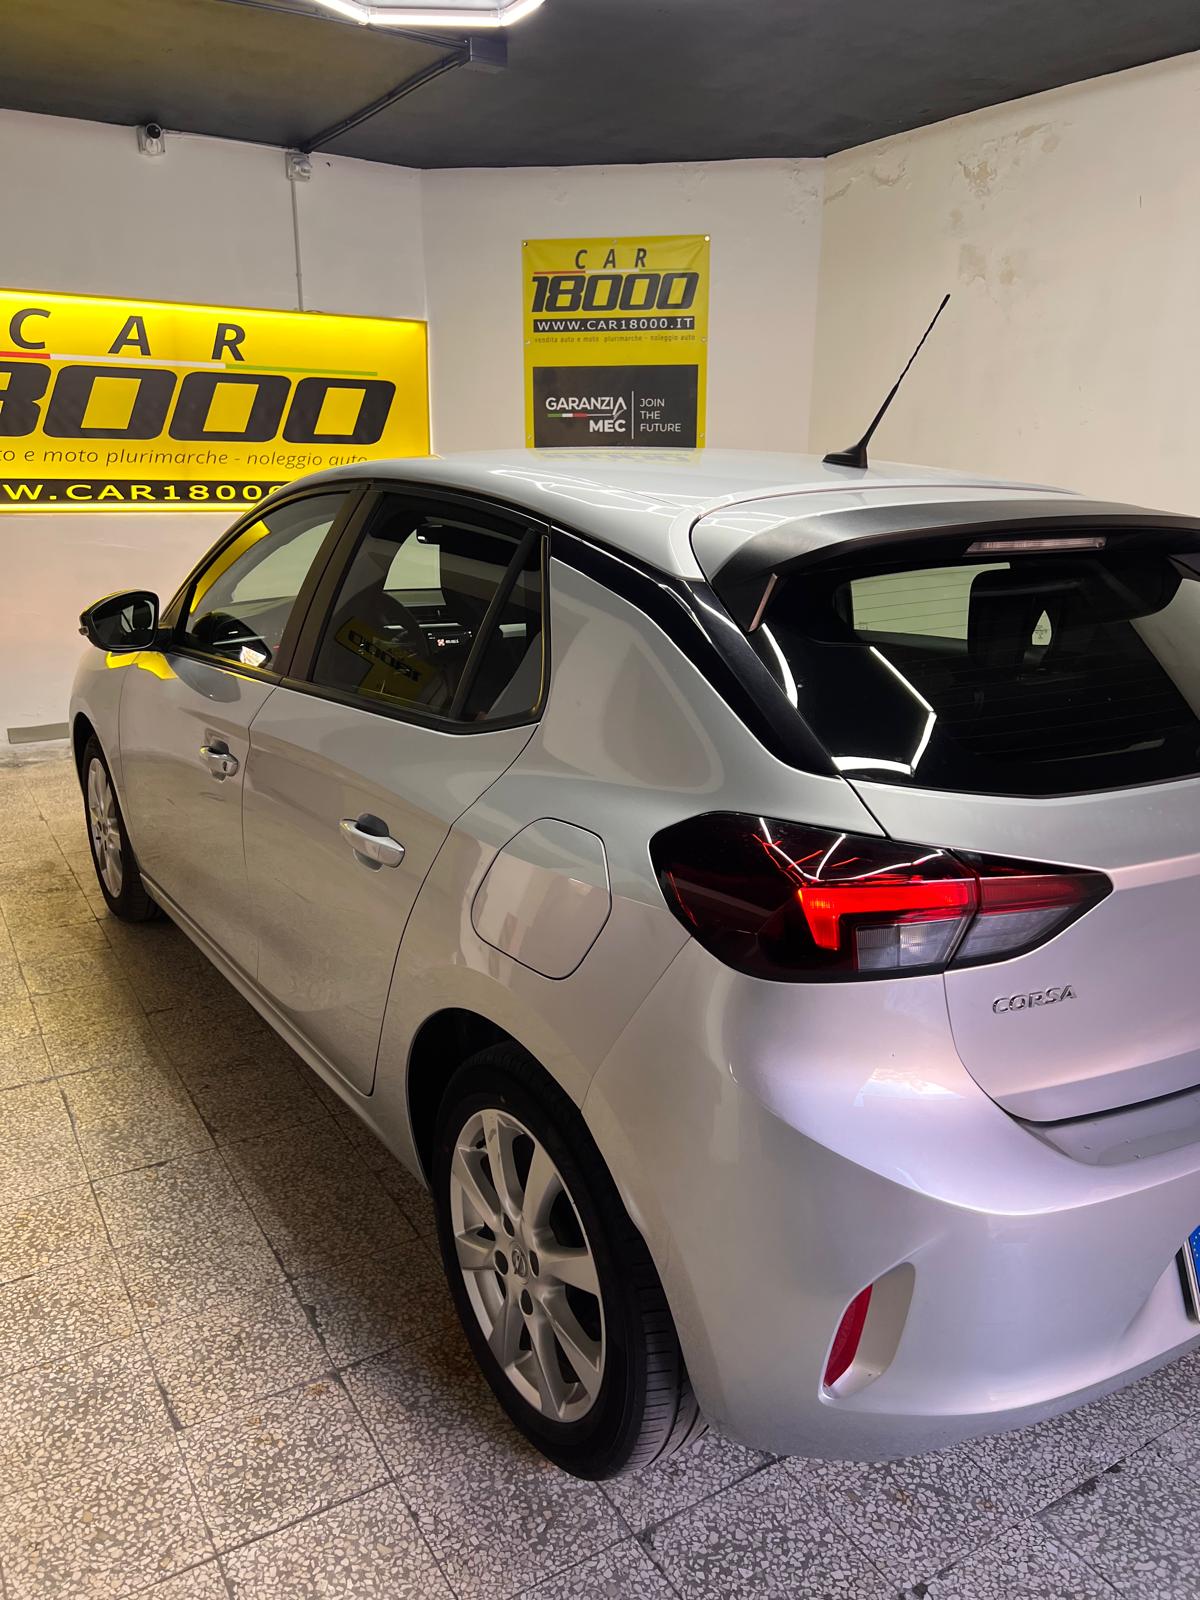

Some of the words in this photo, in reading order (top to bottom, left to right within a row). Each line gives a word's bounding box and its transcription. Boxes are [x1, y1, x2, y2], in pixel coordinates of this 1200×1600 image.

[575, 248, 647, 269] CAR
[532, 272, 699, 312] 18000
[537, 318, 693, 331] WWW.CAR18000.IT
[9, 308, 246, 361] CAR
[545, 397, 627, 414] GARANZIA
[640, 398, 665, 408] JOIN
[640, 411, 661, 420] THE
[589, 420, 626, 433] MEC
[640, 424, 681, 433] FUTURE
[24, 450, 35, 462] e
[43, 447, 98, 463] moto
[106, 449, 228, 467] plurimarche
[247, 451, 322, 470] noleggio
[992, 984, 1077, 1014] CORSA
